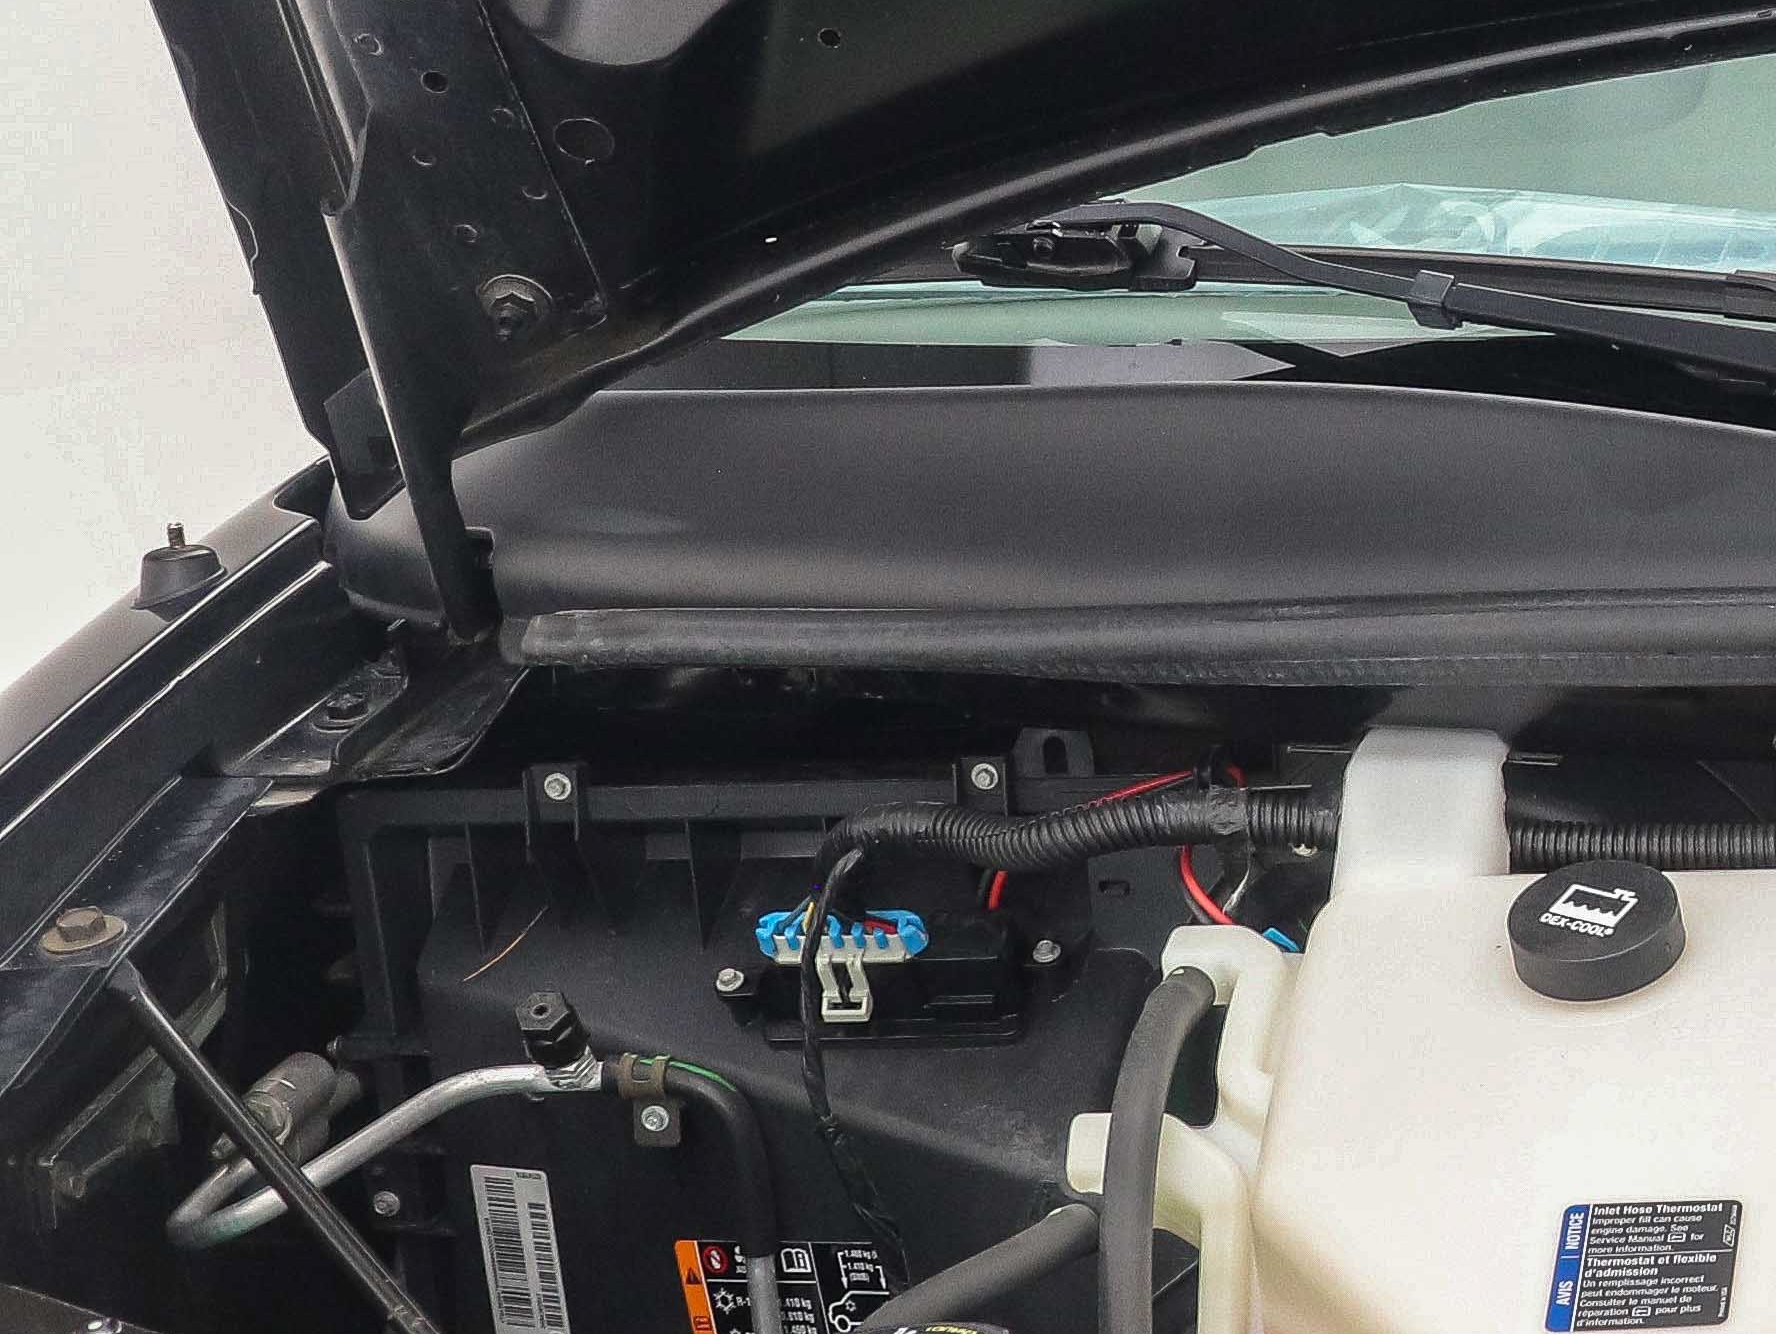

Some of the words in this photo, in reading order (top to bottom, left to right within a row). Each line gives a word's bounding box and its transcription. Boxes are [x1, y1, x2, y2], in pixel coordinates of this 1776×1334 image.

[1594, 1207, 1620, 1216] Inlet
[1624, 1206, 1653, 1215] Hose
[1657, 1203, 1723, 1214] Thermostat
[1593, 1216, 1636, 1226] Improper
[1638, 1216, 1651, 1224] fill
[1674, 1215, 1702, 1223] cause
[1565, 1212, 1585, 1250] NOTICE
[1591, 1226, 1623, 1235] engine
[1626, 1225, 1667, 1235] damage.
[1670, 1224, 1689, 1233] See
[1589, 1236, 1625, 1245] Service
[1628, 1235, 1664, 1243] Manual
[1690, 1233, 1705, 1241] for
[1588, 1246, 1612, 1254] more
[1615, 1244, 1674, 1253] information.
[1587, 1256, 1654, 1267] Thermostat
[1658, 1256, 1669, 1264] et
[1673, 1254, 1717, 1264] flexible
[1585, 1268, 1658, 1278] d'admission
[1583, 1280, 1596, 1288] Un
[1599, 1278, 1658, 1288] remplissage
[1661, 1275, 1705, 1284] incorrect
[1555, 1281, 1574, 1306] AVIS
[1581, 1290, 1602, 1298] peut
[1605, 1287, 1669, 1298] endommager
[1580, 1299, 1626, 1308] Consulter
[1641, 1296, 1677, 1305] manuel
[1655, 1306, 1678, 1315] pour
[1680, 1305, 1702, 1314] plus
[1577, 1317, 1645, 1327] d'information.
